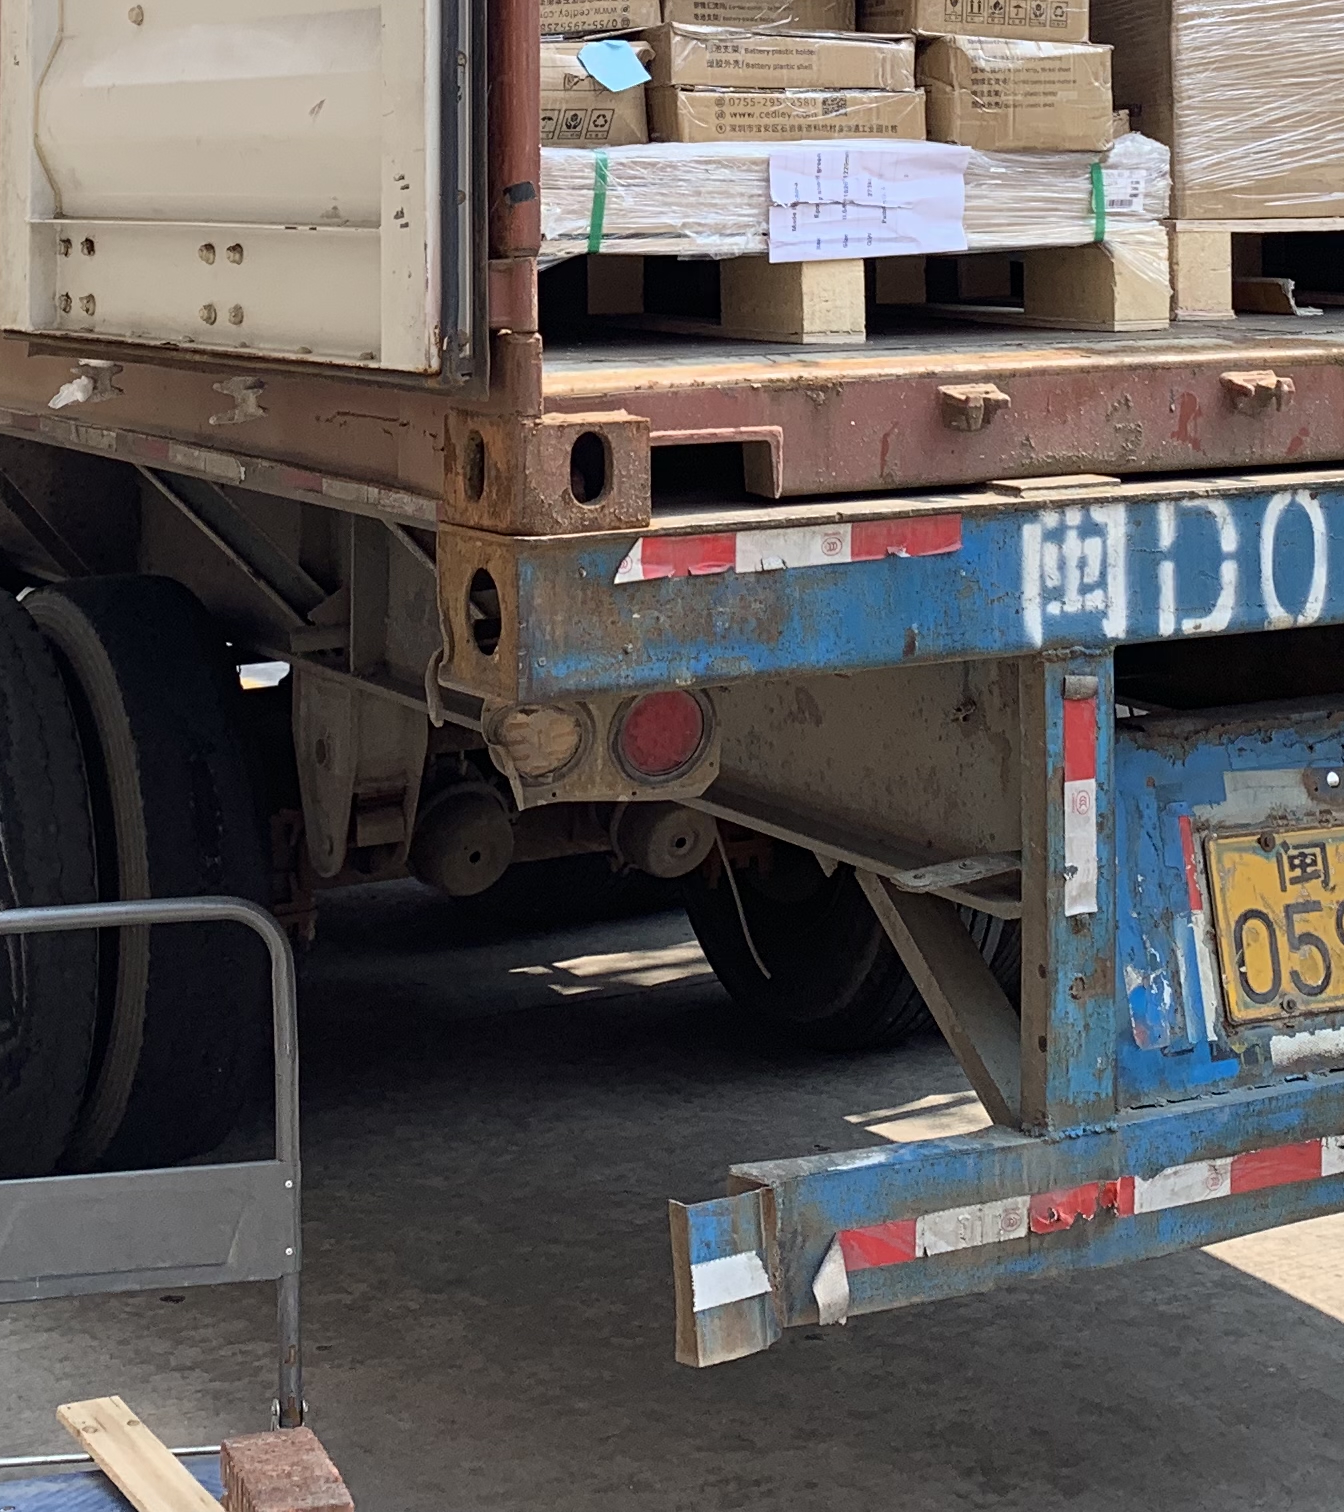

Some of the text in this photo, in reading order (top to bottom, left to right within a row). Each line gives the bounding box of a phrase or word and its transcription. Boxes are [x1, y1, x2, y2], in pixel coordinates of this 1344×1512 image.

[744, 47, 770, 56] Battery
[771, 48, 794, 57] plastic
[745, 62, 771, 71] Battery
[773, 63, 795, 72] plastic
